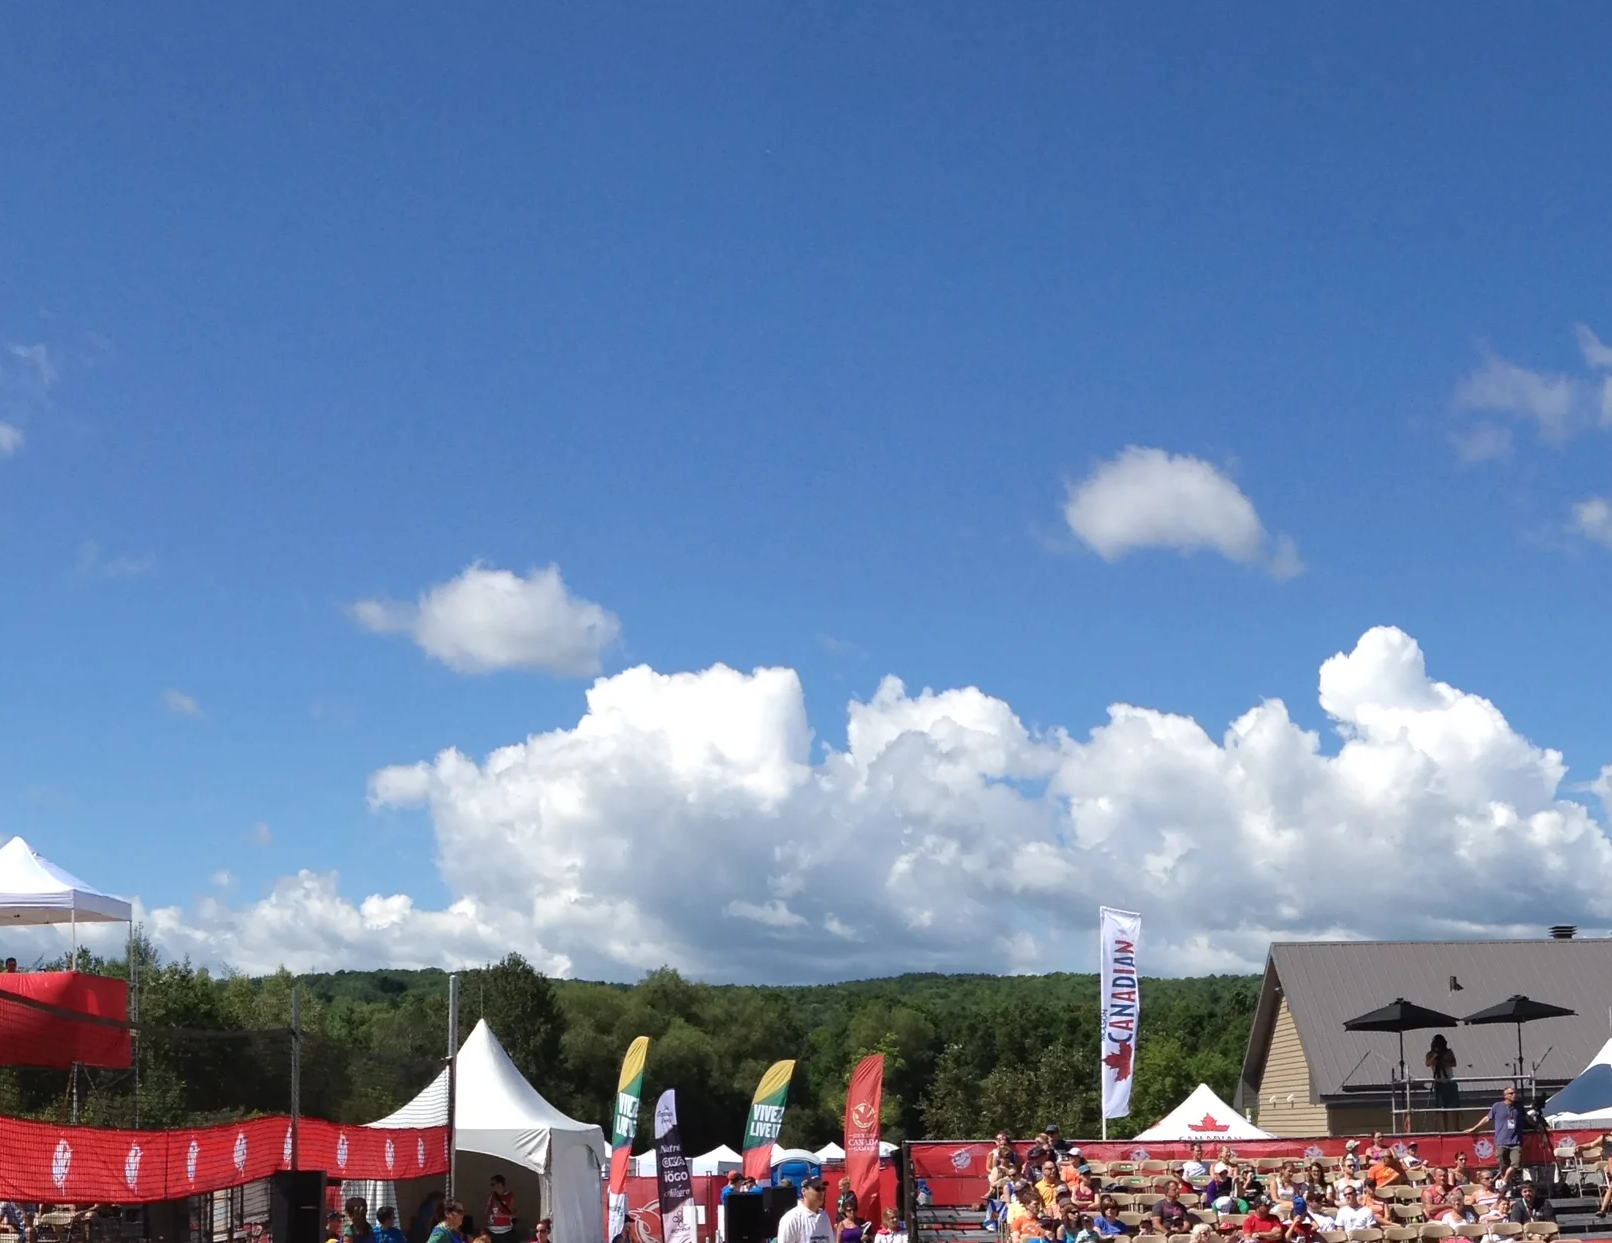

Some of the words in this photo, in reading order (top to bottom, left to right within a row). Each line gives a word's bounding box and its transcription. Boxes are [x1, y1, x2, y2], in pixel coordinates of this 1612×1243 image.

[1107, 939, 1137, 1044] CANADIAN
[752, 1104, 785, 1123] VIVEZ
[749, 1121, 771, 1137] LIVE
[847, 1137, 879, 1146] CANADA
[661, 1155, 686, 1167] OKA
